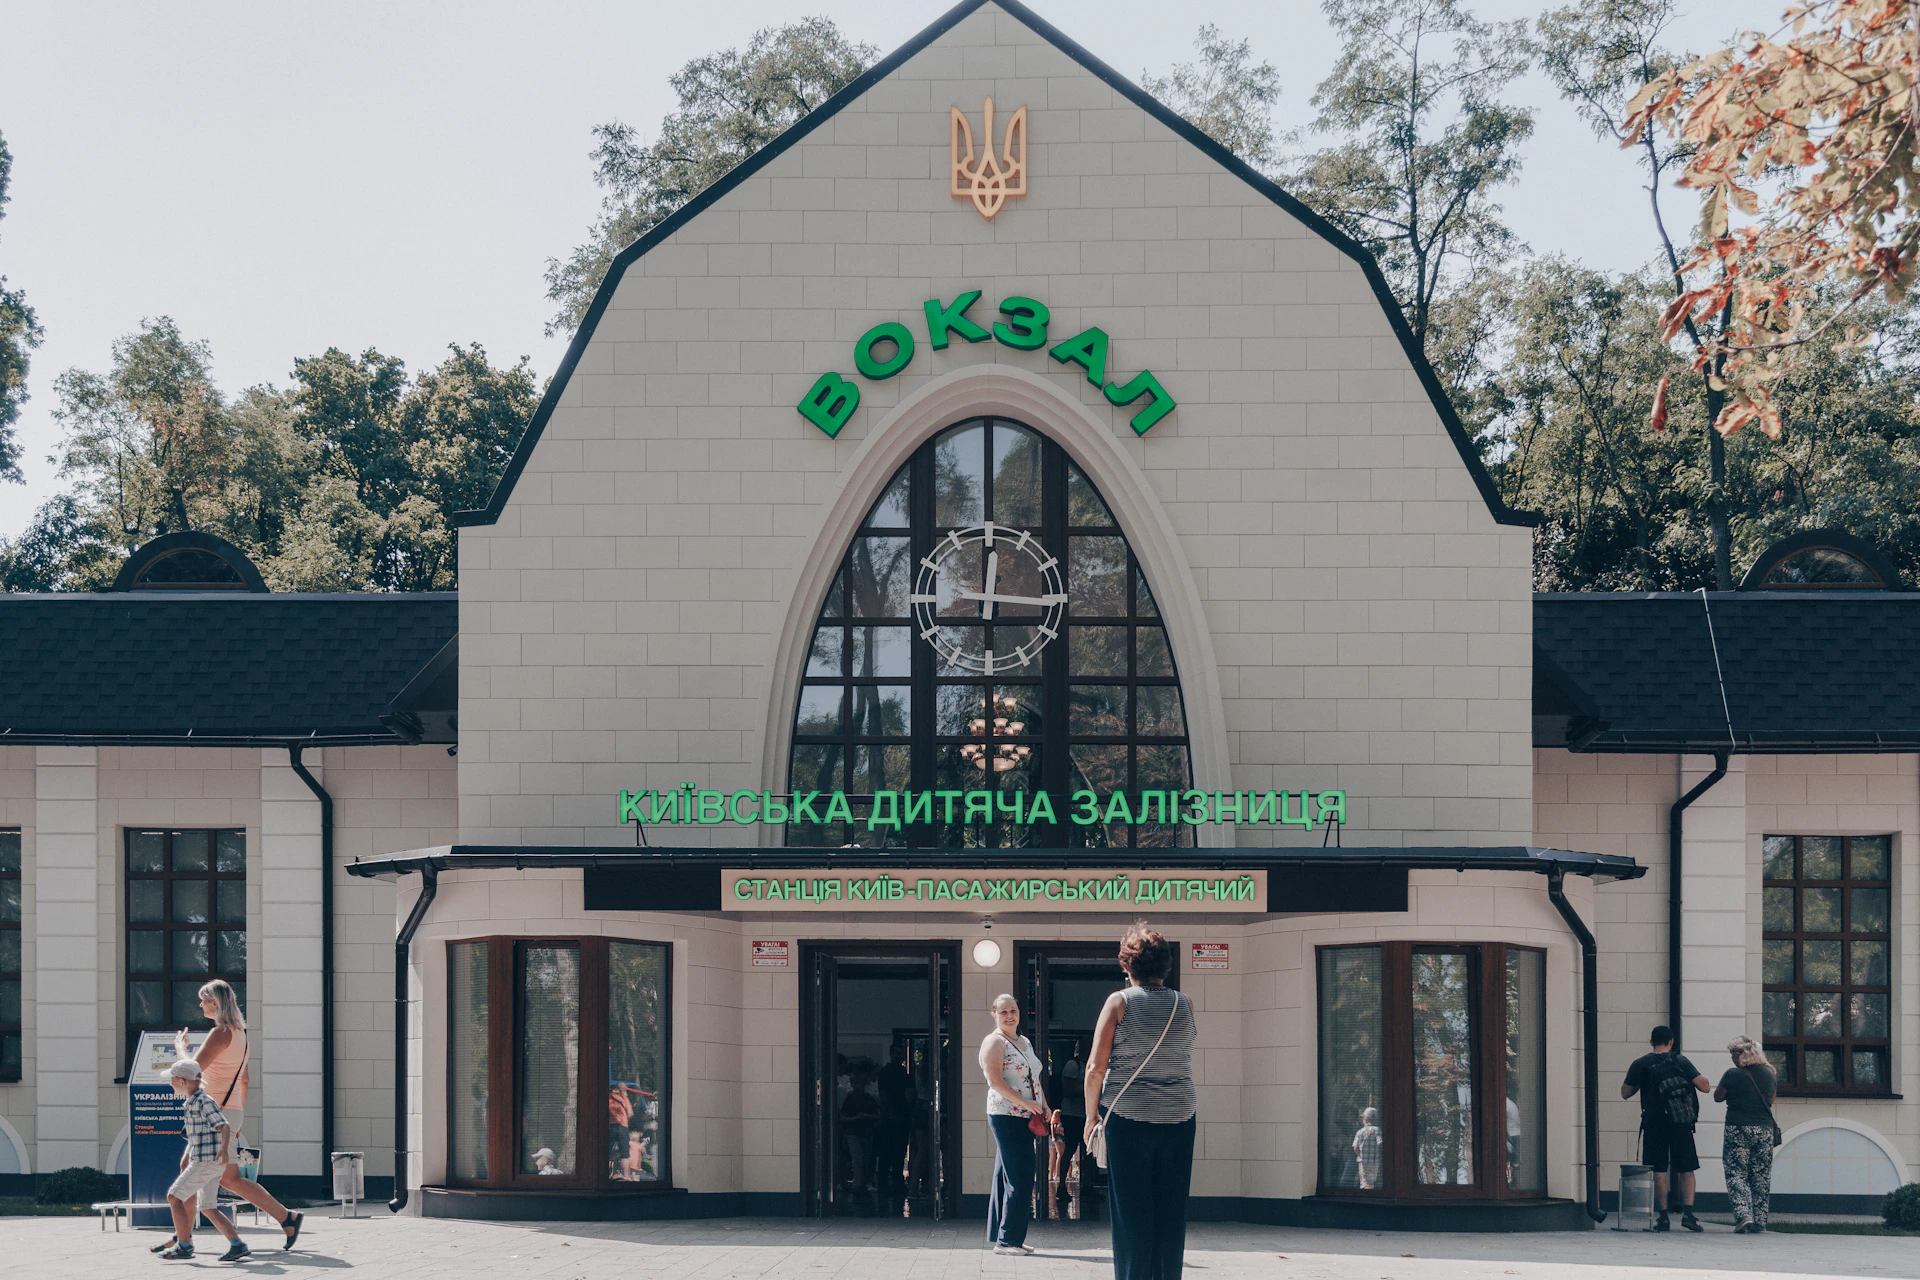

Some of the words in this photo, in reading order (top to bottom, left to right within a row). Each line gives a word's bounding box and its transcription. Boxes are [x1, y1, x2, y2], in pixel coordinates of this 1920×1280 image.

[797, 290, 1176, 439] ВОКЗАЛ
[619, 782, 855, 825] КИЇВСЬКА
[867, 789, 1058, 832] ДИТЯЧА
[1070, 789, 1347, 832] ЗАЛІЗНИЦЯ
[733, 878, 841, 905] СТАНЦІЯ
[847, 875, 1130, 901] КИЇВ-ПАСАЖИРСЬКИЙ
[1135, 875, 1255, 905] ДИТЯЧИЙ
[134, 1093, 187, 1101] УКРЗАЛІЗНИ
